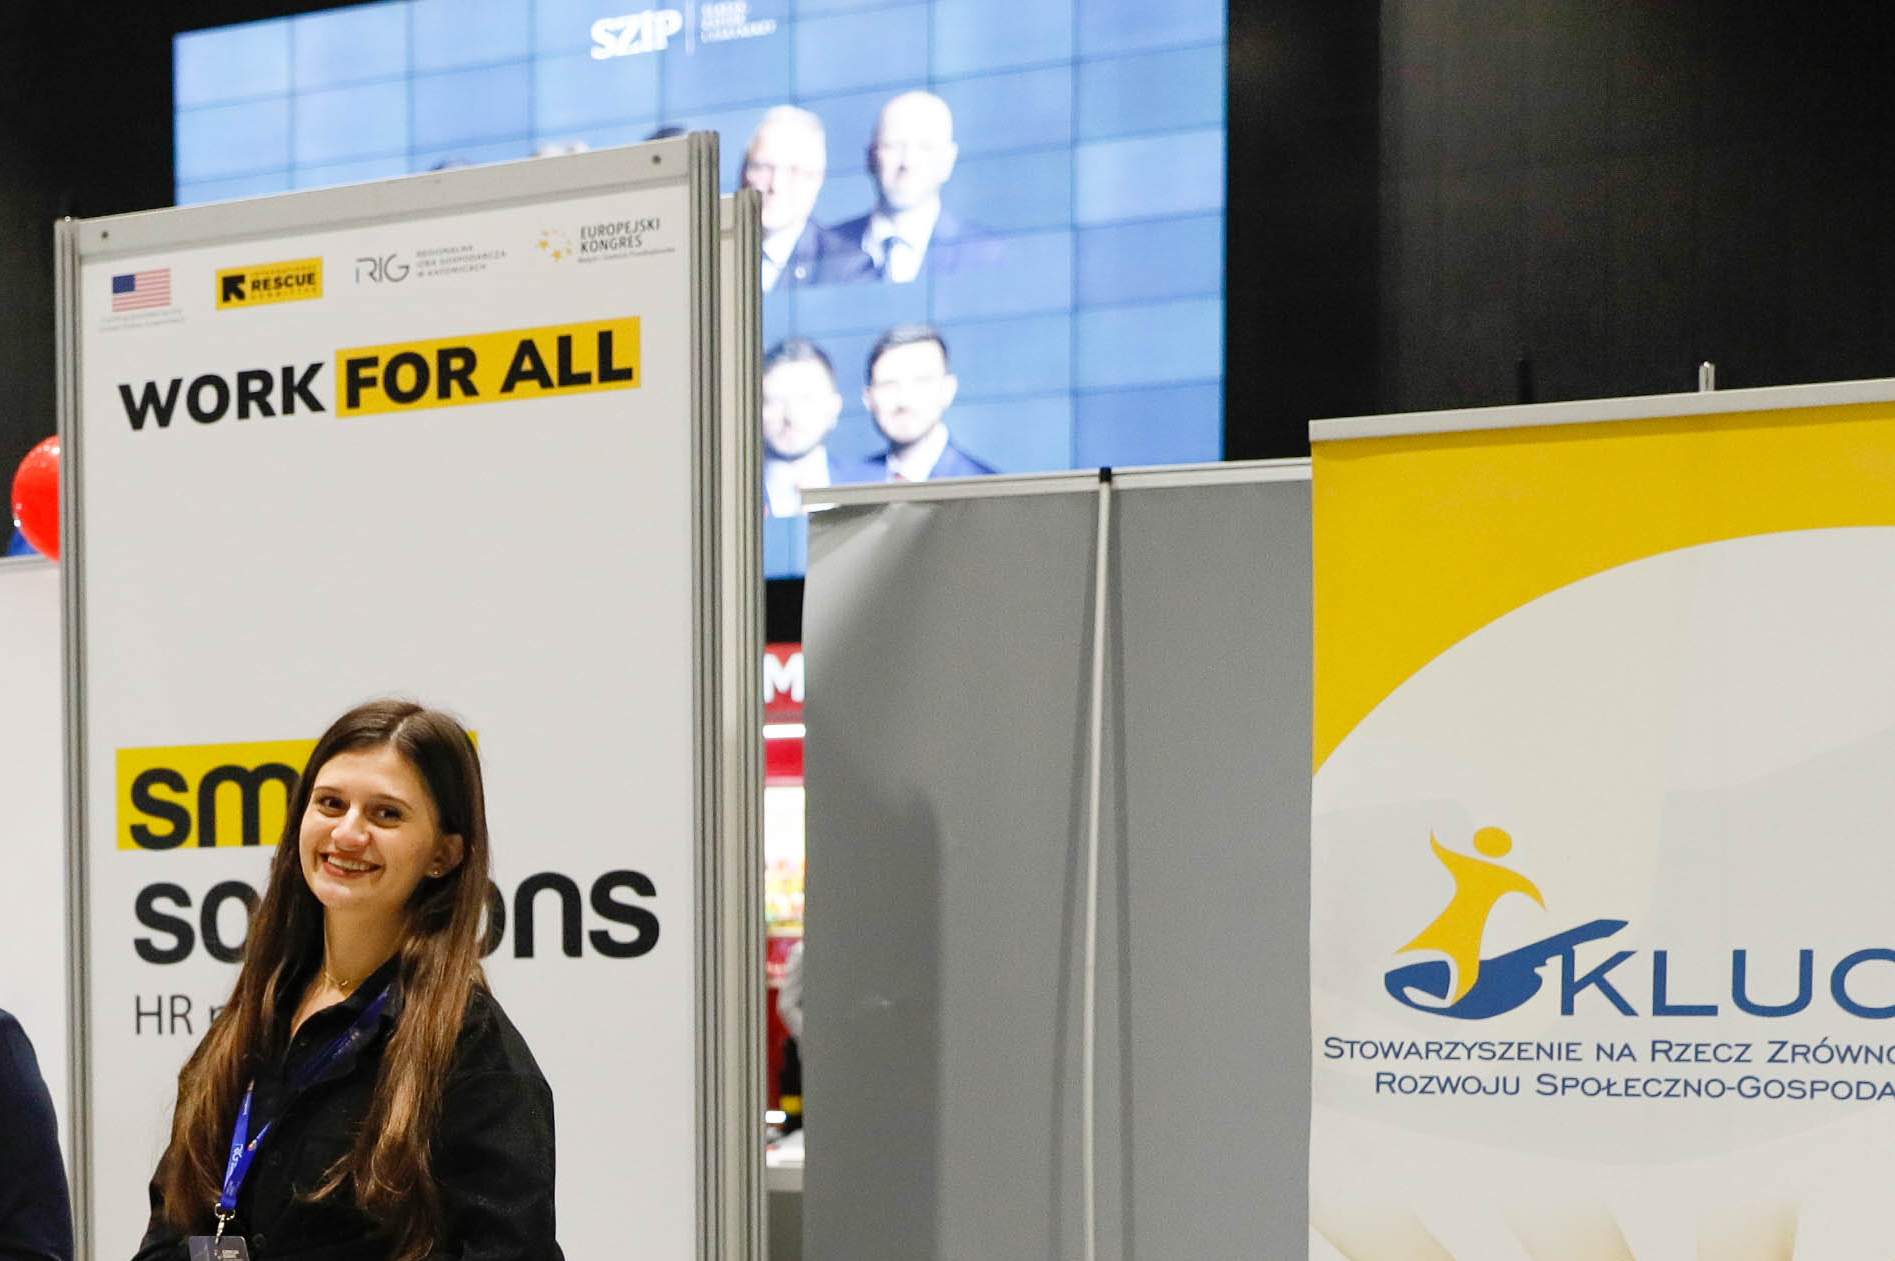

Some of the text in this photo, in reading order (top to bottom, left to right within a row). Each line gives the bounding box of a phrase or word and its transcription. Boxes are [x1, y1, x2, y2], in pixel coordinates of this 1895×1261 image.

[591, 10, 683, 60] SZIP
[580, 217, 661, 240] EUROPEJSKI
[579, 234, 643, 254] KONGRES
[251, 272, 316, 292] RESCUE
[119, 329, 634, 431] WORK FOR ALL
[134, 995, 193, 1036] HR
[1324, 1037, 1582, 1062] STOWARZYSZENIE
[1651, 1040, 1752, 1064] RZECZ
[1375, 1072, 1895, 1101] ROZWOJU SPOŁECZNO-GOSPODA
